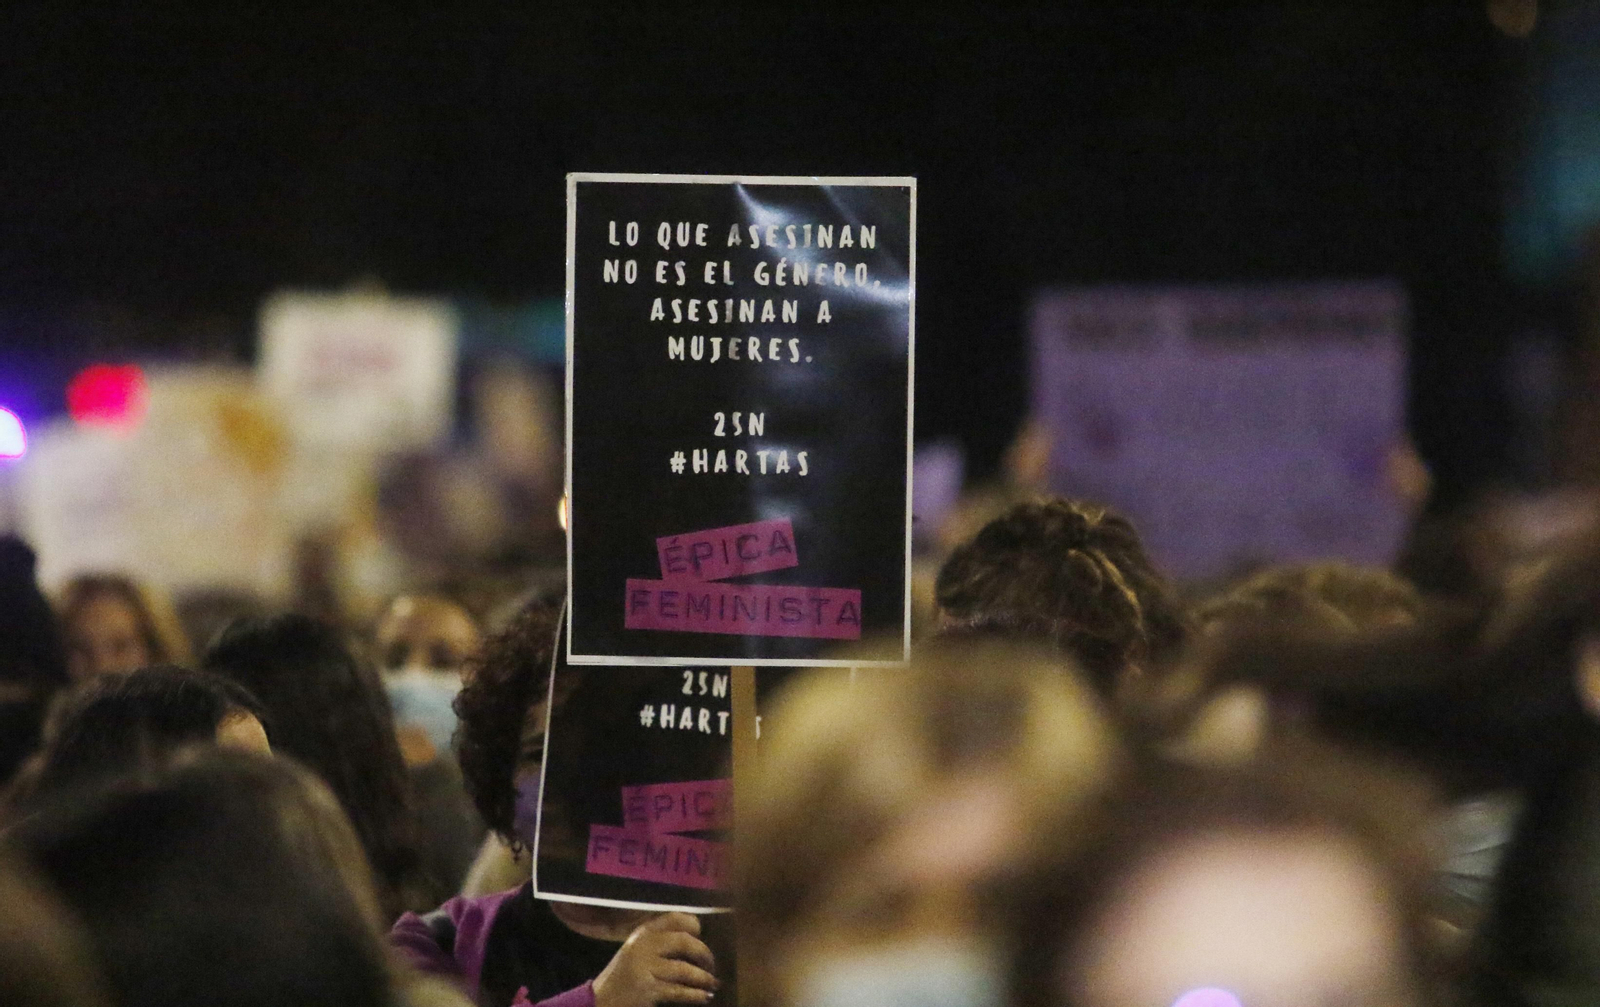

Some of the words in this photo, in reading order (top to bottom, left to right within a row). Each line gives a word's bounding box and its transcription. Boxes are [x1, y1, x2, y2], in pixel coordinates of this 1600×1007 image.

[609, 221, 638, 246] LO
[657, 222, 708, 251] QUE
[728, 223, 877, 249] ASESINAN
[603, 259, 638, 284] NO
[656, 261, 686, 285] ES
[704, 261, 734, 285] EL
[650, 298, 798, 323] ASESINAN
[817, 300, 832, 324] A
[668, 336, 813, 363] MUJERES.
[670, 448, 810, 476] #HARTAS
[663, 529, 792, 574] ÉPICA
[629, 588, 861, 627] FEMINISTA
[628, 788, 715, 824] ÉPIC
